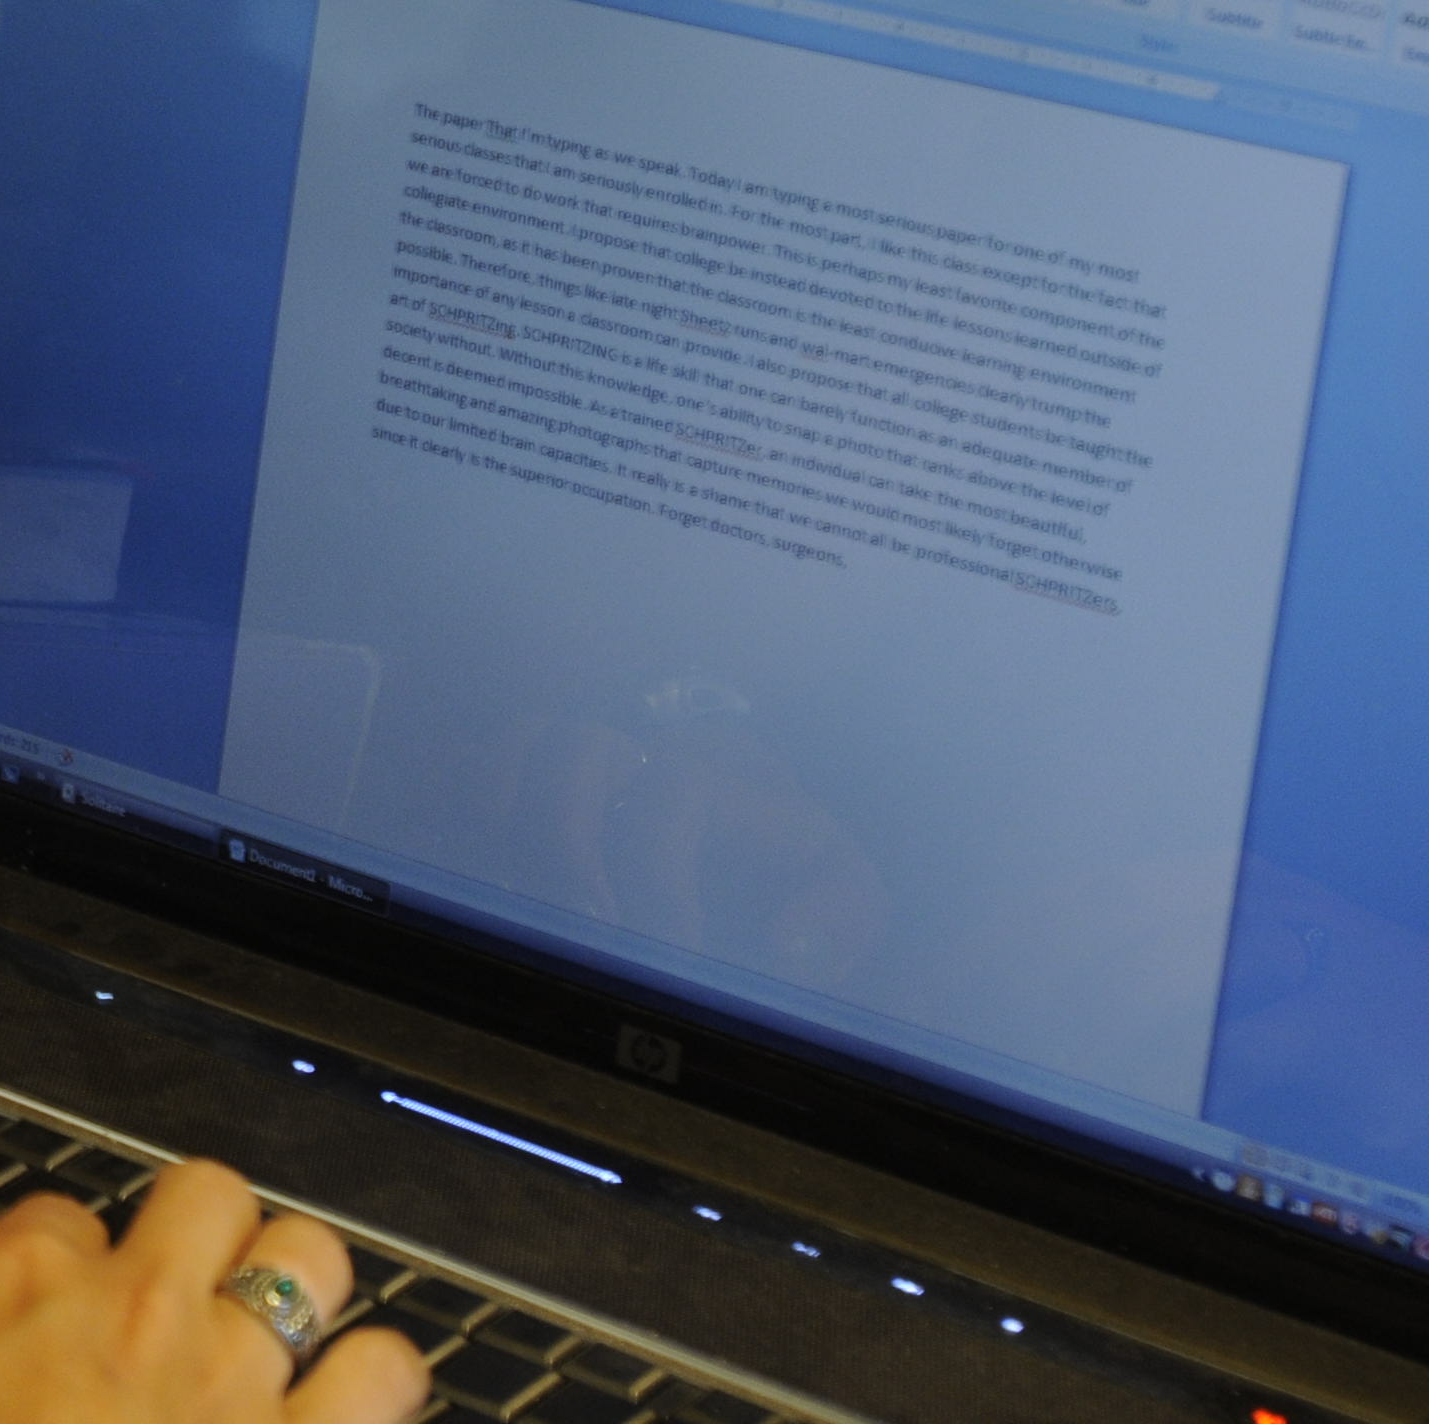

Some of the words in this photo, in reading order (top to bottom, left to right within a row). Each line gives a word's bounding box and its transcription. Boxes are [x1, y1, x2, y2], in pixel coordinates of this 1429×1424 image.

[410, 132, 462, 155] serious
[463, 142, 511, 166] classes
[578, 171, 644, 201] seriously
[644, 186, 710, 213] enrolled
[942, 253, 979, 276] class
[981, 264, 1040, 292] except
[441, 111, 483, 132] paper
[545, 131, 591, 161] typing
[688, 164, 734, 194] Today
[771, 183, 821, 214] typing
[877, 211, 935, 236] serious
[935, 224, 983, 247] paper
[454, 166, 503, 193] forced
[616, 208, 679, 235] requires
[819, 257, 885, 285] perhaps
[915, 275, 954, 300] least
[954, 284, 1019, 315] favorite
[1020, 304, 1115, 338] component
[403, 185, 470, 212] collegiate
[578, 227, 639, 253] propose
[673, 250, 727, 276] college
[750, 264, 807, 293] instead
[808, 278, 876, 310] devoted
[952, 313, 1013, 343] lessons
[1013, 327, 1079, 359] learned
[1079, 347, 1142, 374] outside
[537, 271, 583, 299] things
[640, 299, 679, 321] night
[872, 358, 975, 395] emergencies
[976, 381, 1030, 412] clearly
[1030, 392, 1083, 426] trump
[602, 262, 655, 286] proven
[716, 287, 793, 320] classroom
[838, 315, 876, 340] least
[879, 329, 962, 361] conducive
[961, 345, 1025, 380] learning
[1029, 366, 1137, 404] environment
[382, 343, 432, 371] decent
[445, 360, 505, 390] deemed
[620, 405, 674, 434] trained
[790, 450, 866, 485] individual
[385, 320, 434, 347] society
[498, 345, 557, 375] Without
[675, 394, 718, 417] one's
[719, 404, 763, 432] ability
[836, 435, 884, 460] photo
[922, 458, 964, 480] ranks
[966, 468, 1019, 495] above
[1050, 487, 1092, 514] level
[392, 262, 472, 297] importance
[518, 294, 565, 321] lesson
[579, 311, 654, 343] classroom
[789, 366, 854, 393] propose
[913, 397, 969, 424] college
[971, 410, 1044, 441] students
[1068, 432, 1125, 461] taught
[671, 362, 700, 383] skill
[799, 393, 848, 425] barely
[850, 406, 917, 438] function
[961, 437, 1038, 469] adequate
[1041, 459, 1114, 489] member
[371, 425, 408, 448] since
[421, 439, 466, 467] clearly
[510, 465, 571, 492] superior
[658, 501, 707, 529] Forget
[378, 369, 467, 411] breathtaking
[497, 404, 554, 434] amazing
[556, 419, 652, 457] photographs
[686, 454, 743, 481] capture
[745, 470, 823, 502] memories
[851, 498, 900, 523] would
[943, 519, 985, 549] likely
[988, 530, 1039, 560] forget
[1040, 547, 1124, 582] otherwise
[448, 415, 498, 443] limited
[499, 429, 536, 453] brain
[630, 468, 670, 493] really
[700, 485, 749, 511] shame
[815, 517, 869, 543] cannot
[915, 544, 1014, 582] professional
